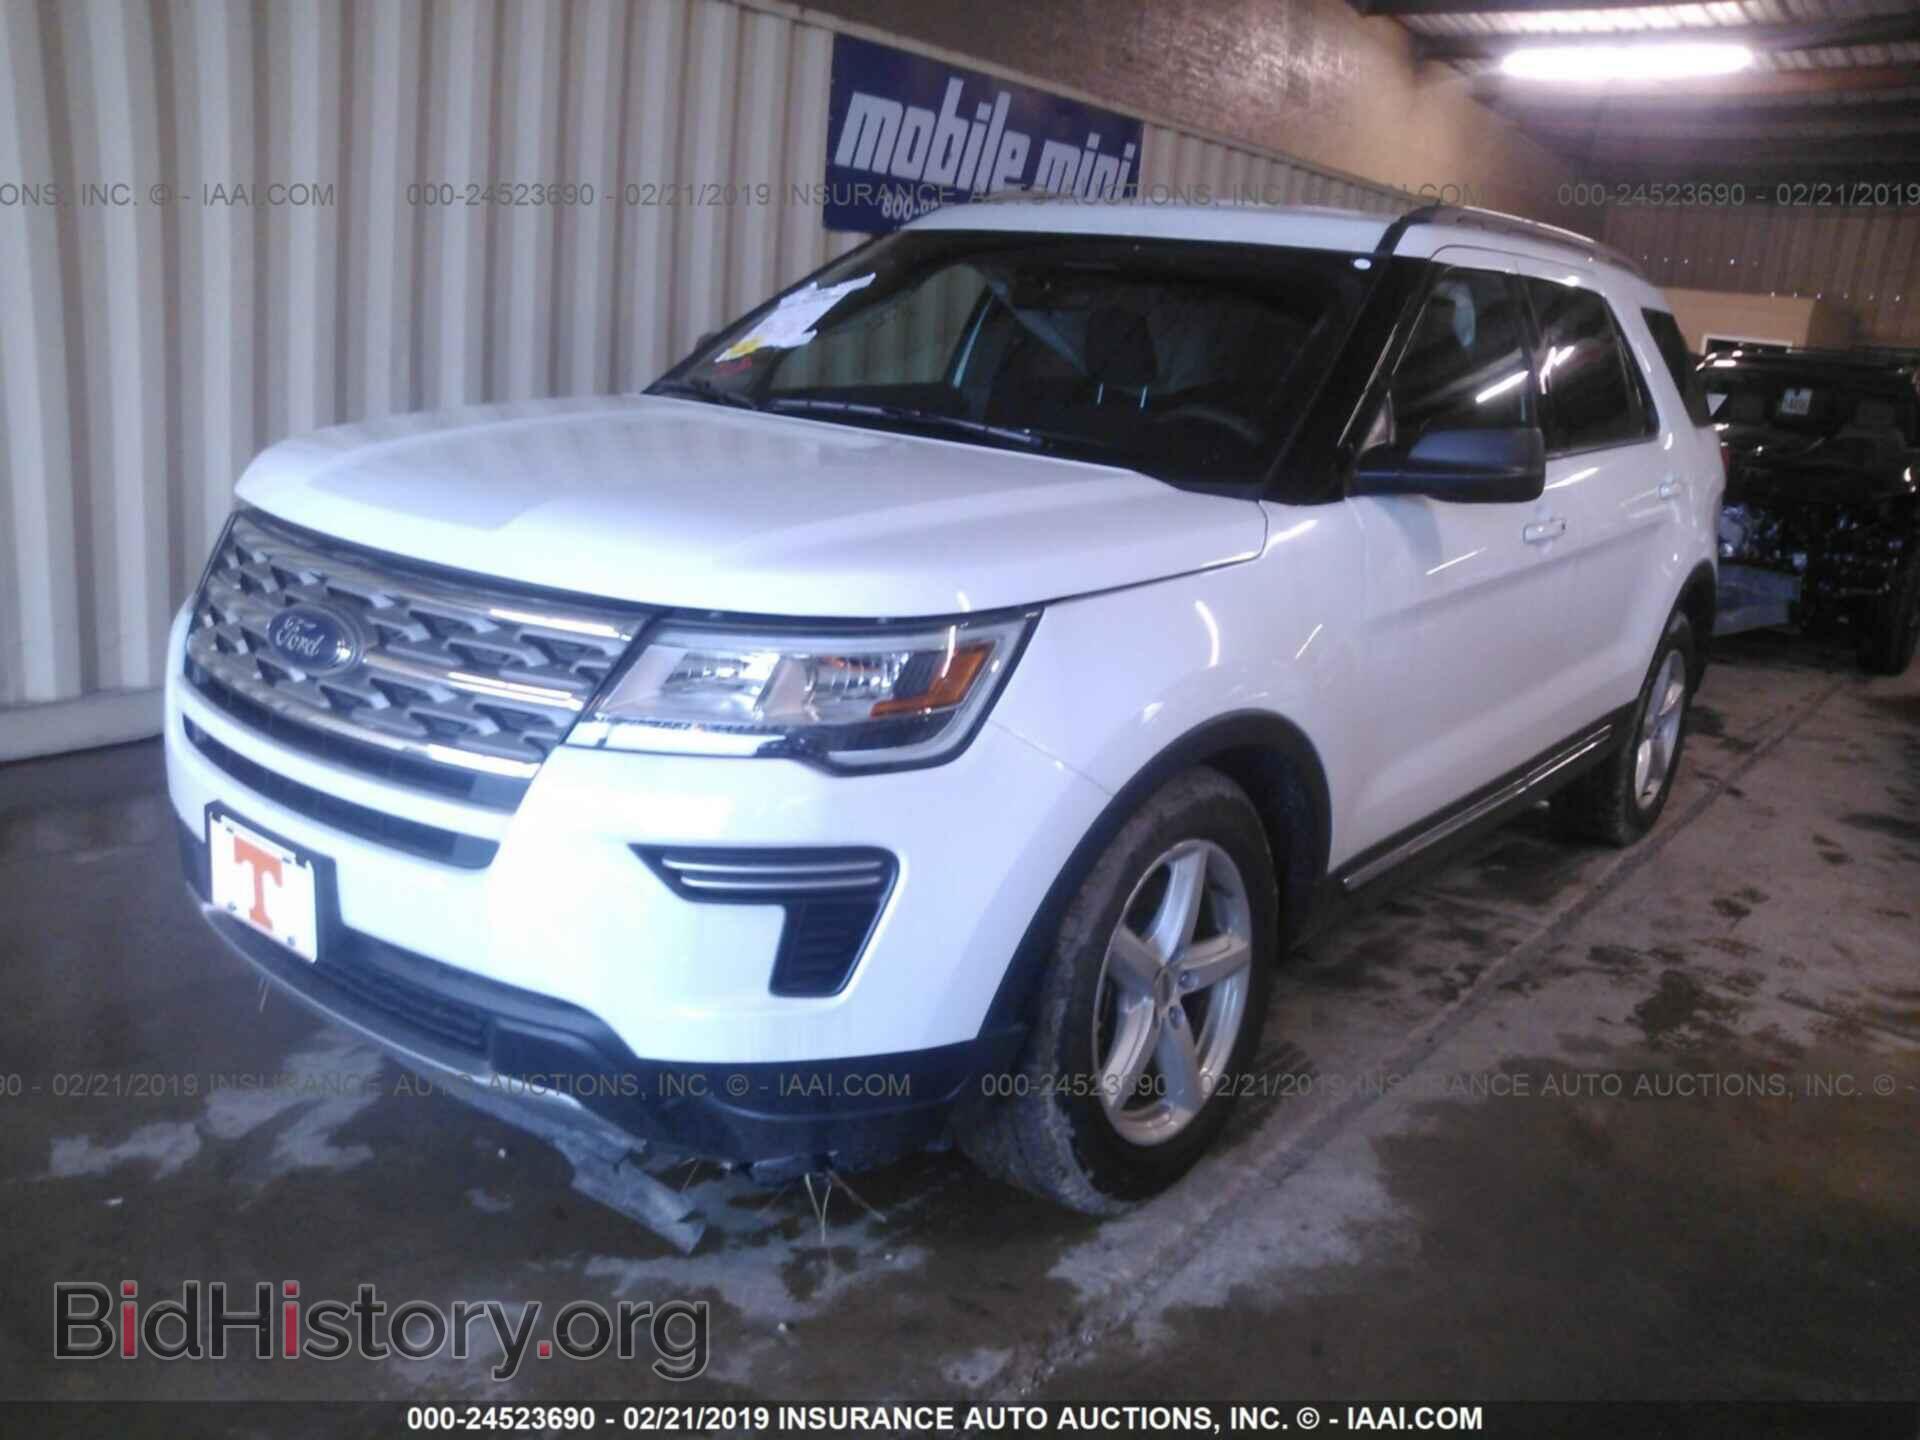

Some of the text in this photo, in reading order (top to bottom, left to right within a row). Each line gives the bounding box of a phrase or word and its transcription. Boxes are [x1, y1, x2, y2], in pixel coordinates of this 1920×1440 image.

[834, 77, 1136, 200] mobile mini
[275, 615, 326, 657] Ford
